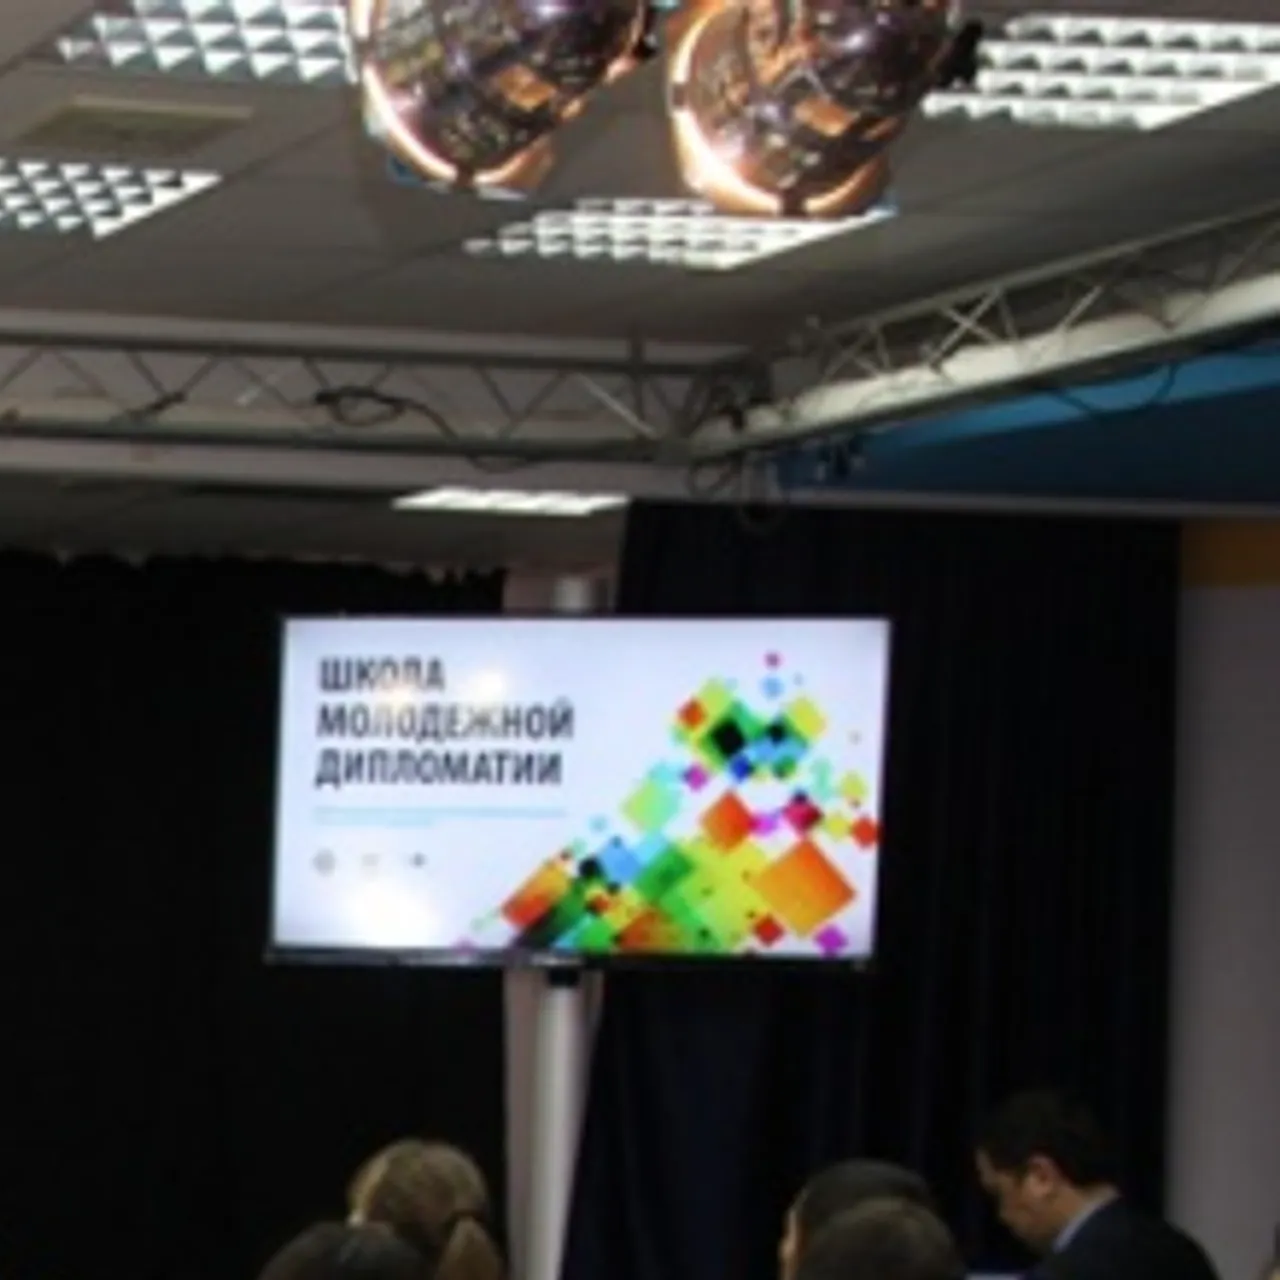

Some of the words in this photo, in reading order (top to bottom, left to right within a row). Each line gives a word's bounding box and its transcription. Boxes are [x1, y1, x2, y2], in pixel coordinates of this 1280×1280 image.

[318, 656, 446, 692] ШКОЛА
[316, 696, 575, 744] МОЛОДЕЖНОЙ
[314, 747, 564, 788] ДИПЛОМАТИИ
